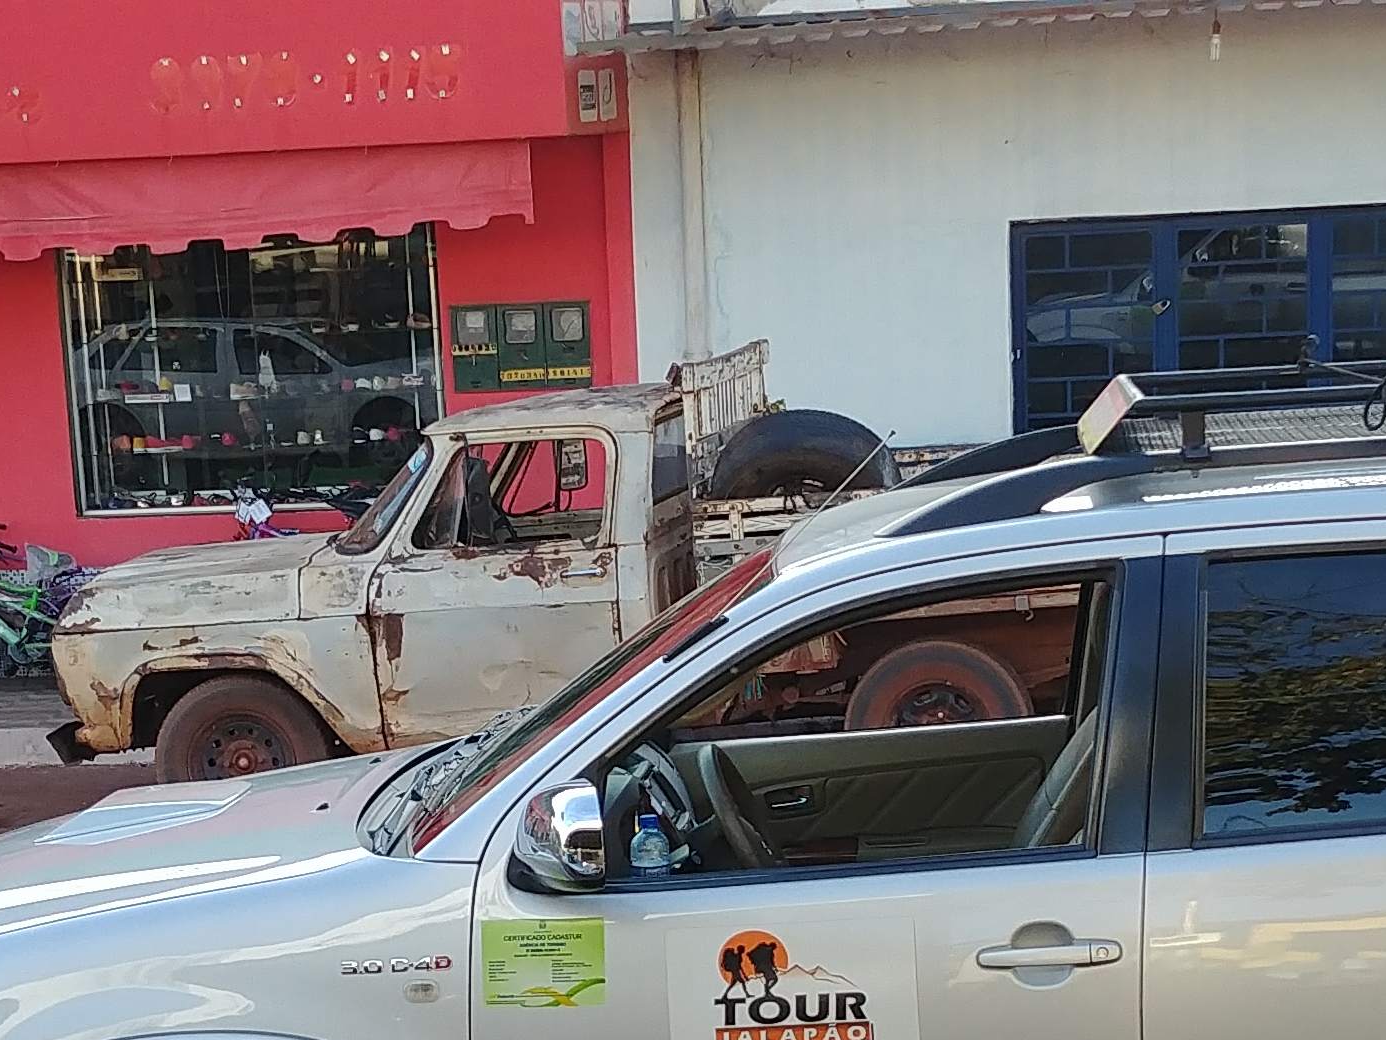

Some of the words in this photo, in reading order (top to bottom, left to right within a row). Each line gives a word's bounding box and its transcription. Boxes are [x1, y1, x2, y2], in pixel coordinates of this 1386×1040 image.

[503, 934, 546, 942] CERTIFICADO
[547, 933, 583, 941] CADASTUR
[340, 959, 384, 976] 3.0
[390, 955, 452, 974] D-4D
[714, 992, 867, 1026] TOUR
